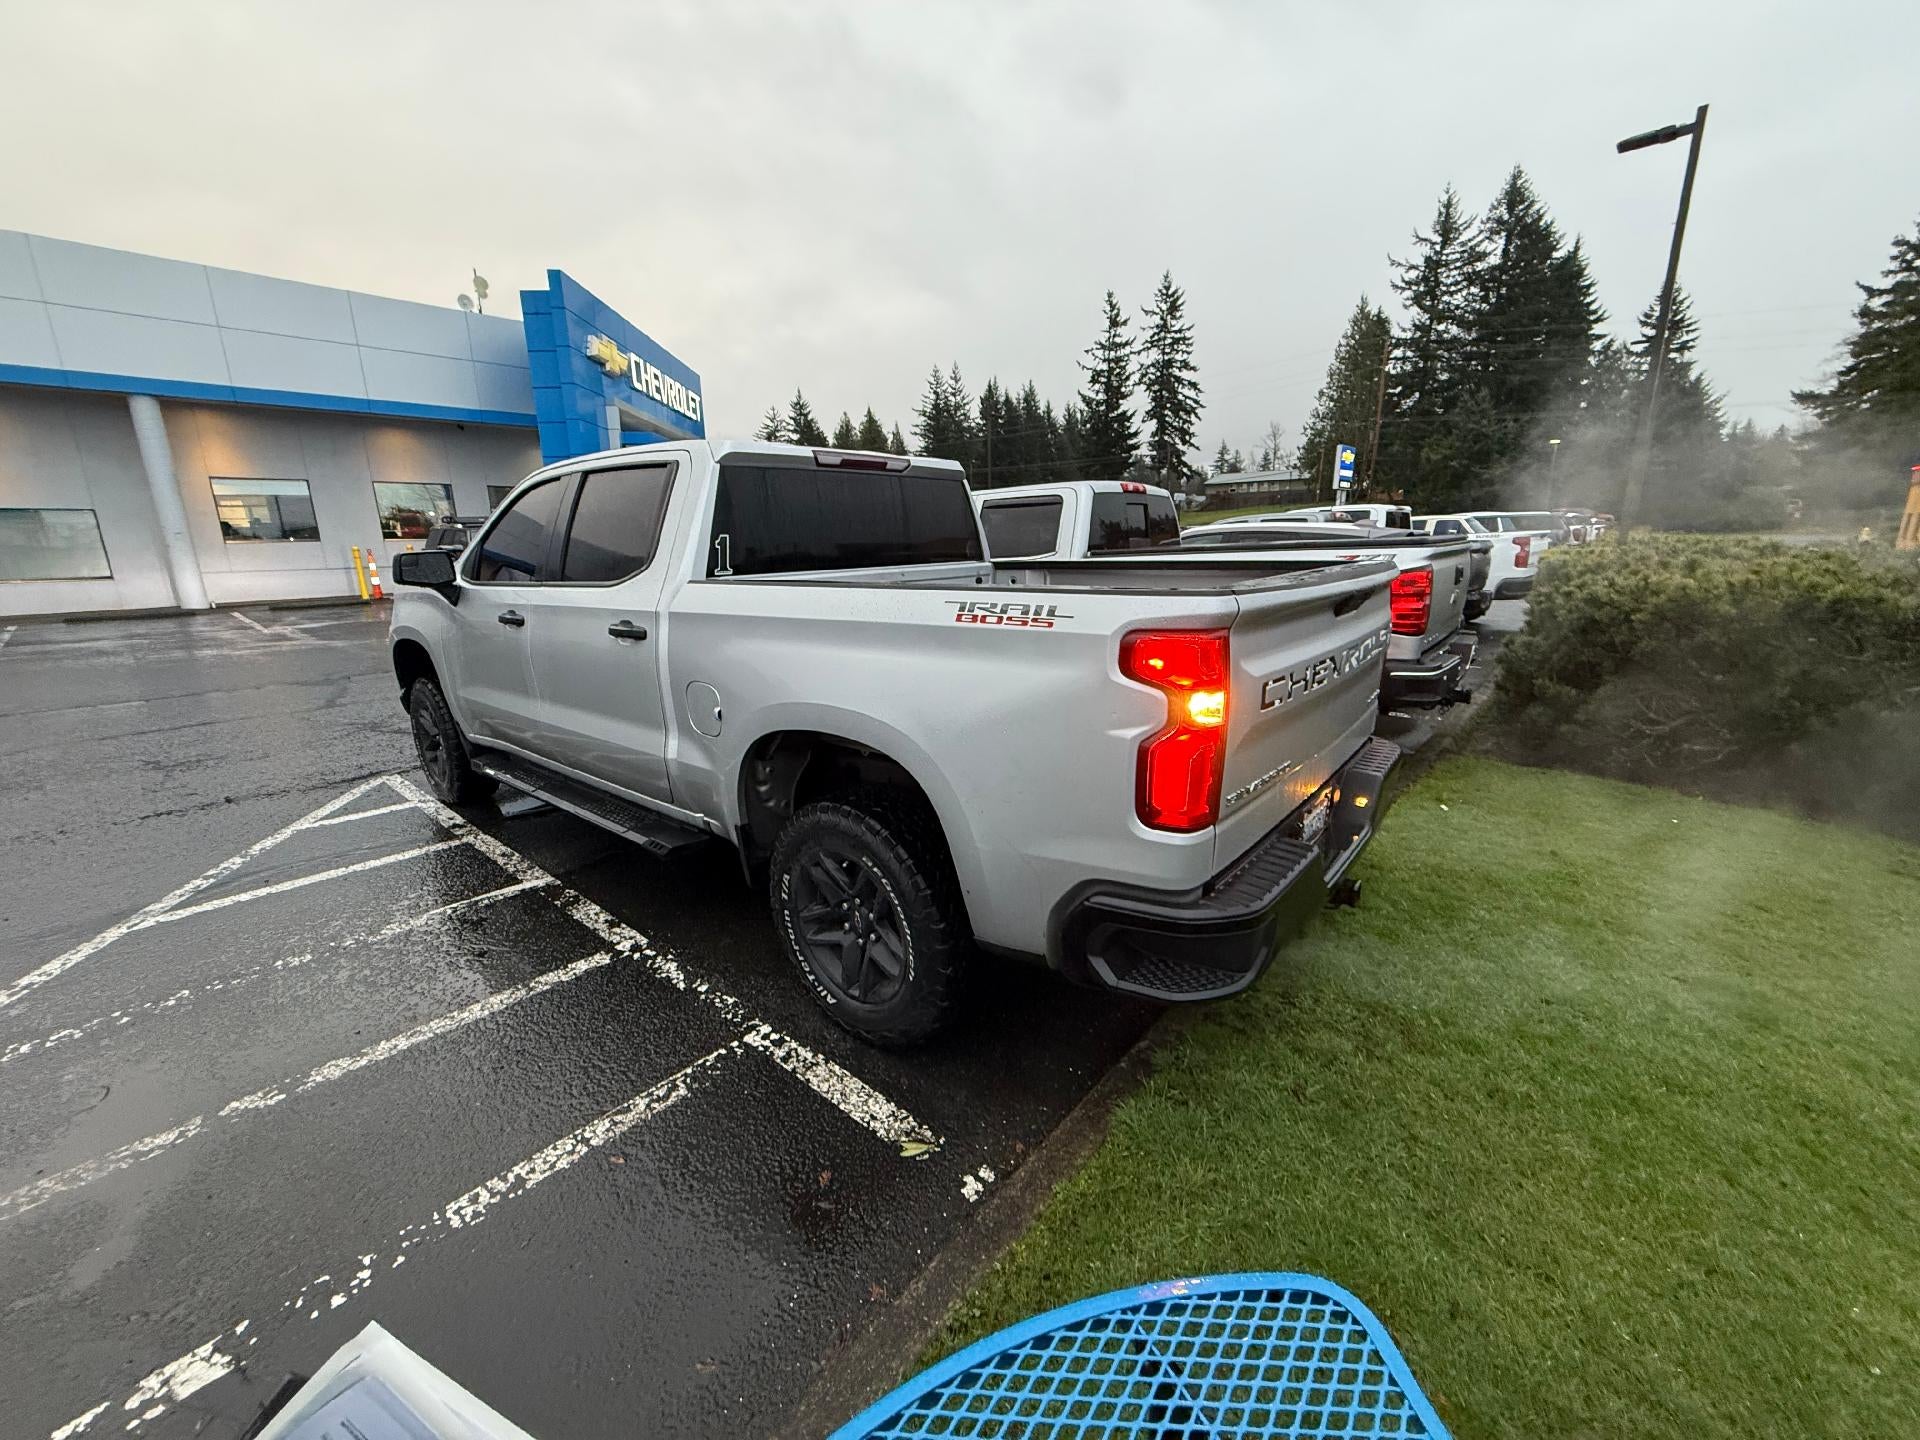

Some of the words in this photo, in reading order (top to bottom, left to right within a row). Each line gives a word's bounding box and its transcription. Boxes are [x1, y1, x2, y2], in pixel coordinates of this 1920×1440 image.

[629, 353, 701, 422] CHEVROLET
[714, 534, 734, 576] 1
[944, 600, 1075, 619] TRAIL
[955, 613, 1056, 629] BOSS
[781, 872, 791, 901] T/A
